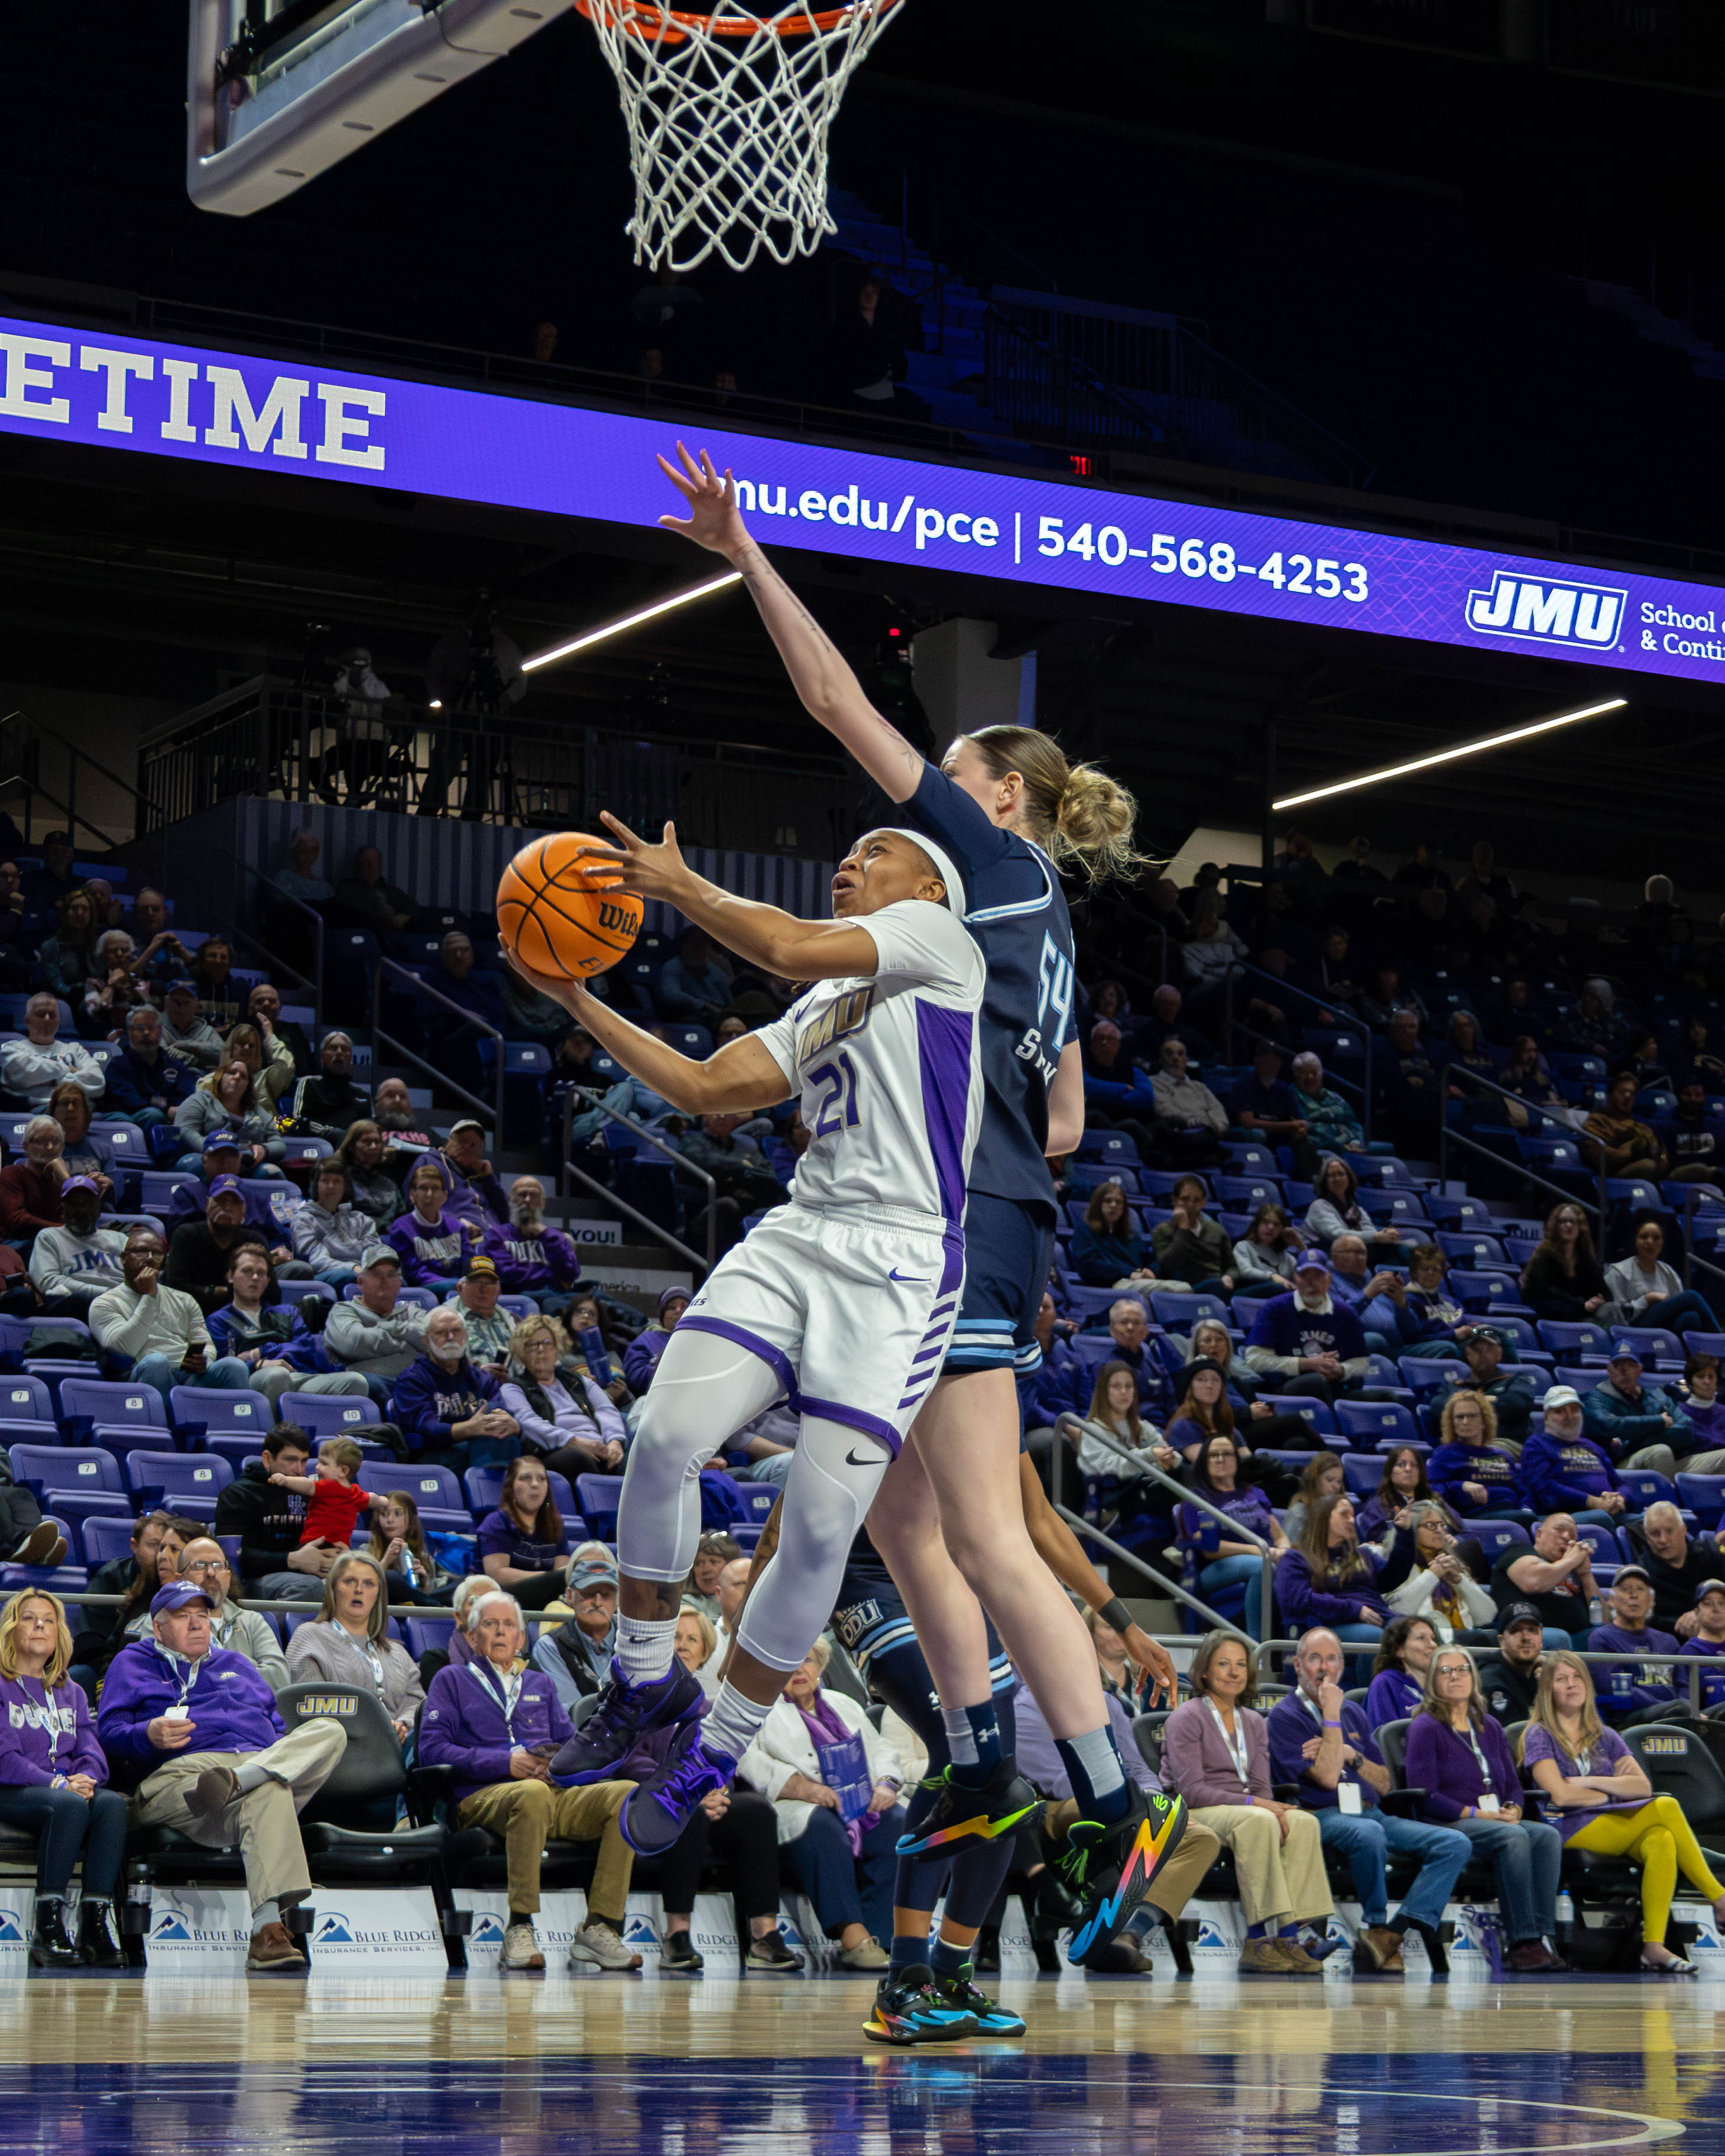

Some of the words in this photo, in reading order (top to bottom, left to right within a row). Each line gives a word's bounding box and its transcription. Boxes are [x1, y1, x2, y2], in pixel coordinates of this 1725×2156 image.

[0, 332, 387, 471] ETIME
[702, 465, 1000, 550] mu.edu/pce
[1037, 515, 1369, 603] 540-568-4253
[1469, 576, 1623, 646] JMU
[1640, 602, 1717, 633] School
[1640, 629, 1658, 651] &
[598, 902, 641, 937] Wils
[1037, 929, 1074, 1053] 54
[806, 1049, 861, 1139] 21
[346, 1411, 358, 1419] 10
[424, 1481, 435, 1489] 10
[841, 1599, 883, 1648] ODU
[297, 1695, 359, 1716] JMU
[1252, 1693, 1291, 1710] JM
[8, 1700, 77, 1739] DUE
[1640, 1736, 1688, 1755] JMU
[193, 1928, 228, 1941] BLUE
[354, 1930, 388, 1943] BLUE
[393, 1929, 440, 1942] RIDGE
[547, 1930, 574, 1942] RID
[1001, 1934, 1032, 1946] DGE
